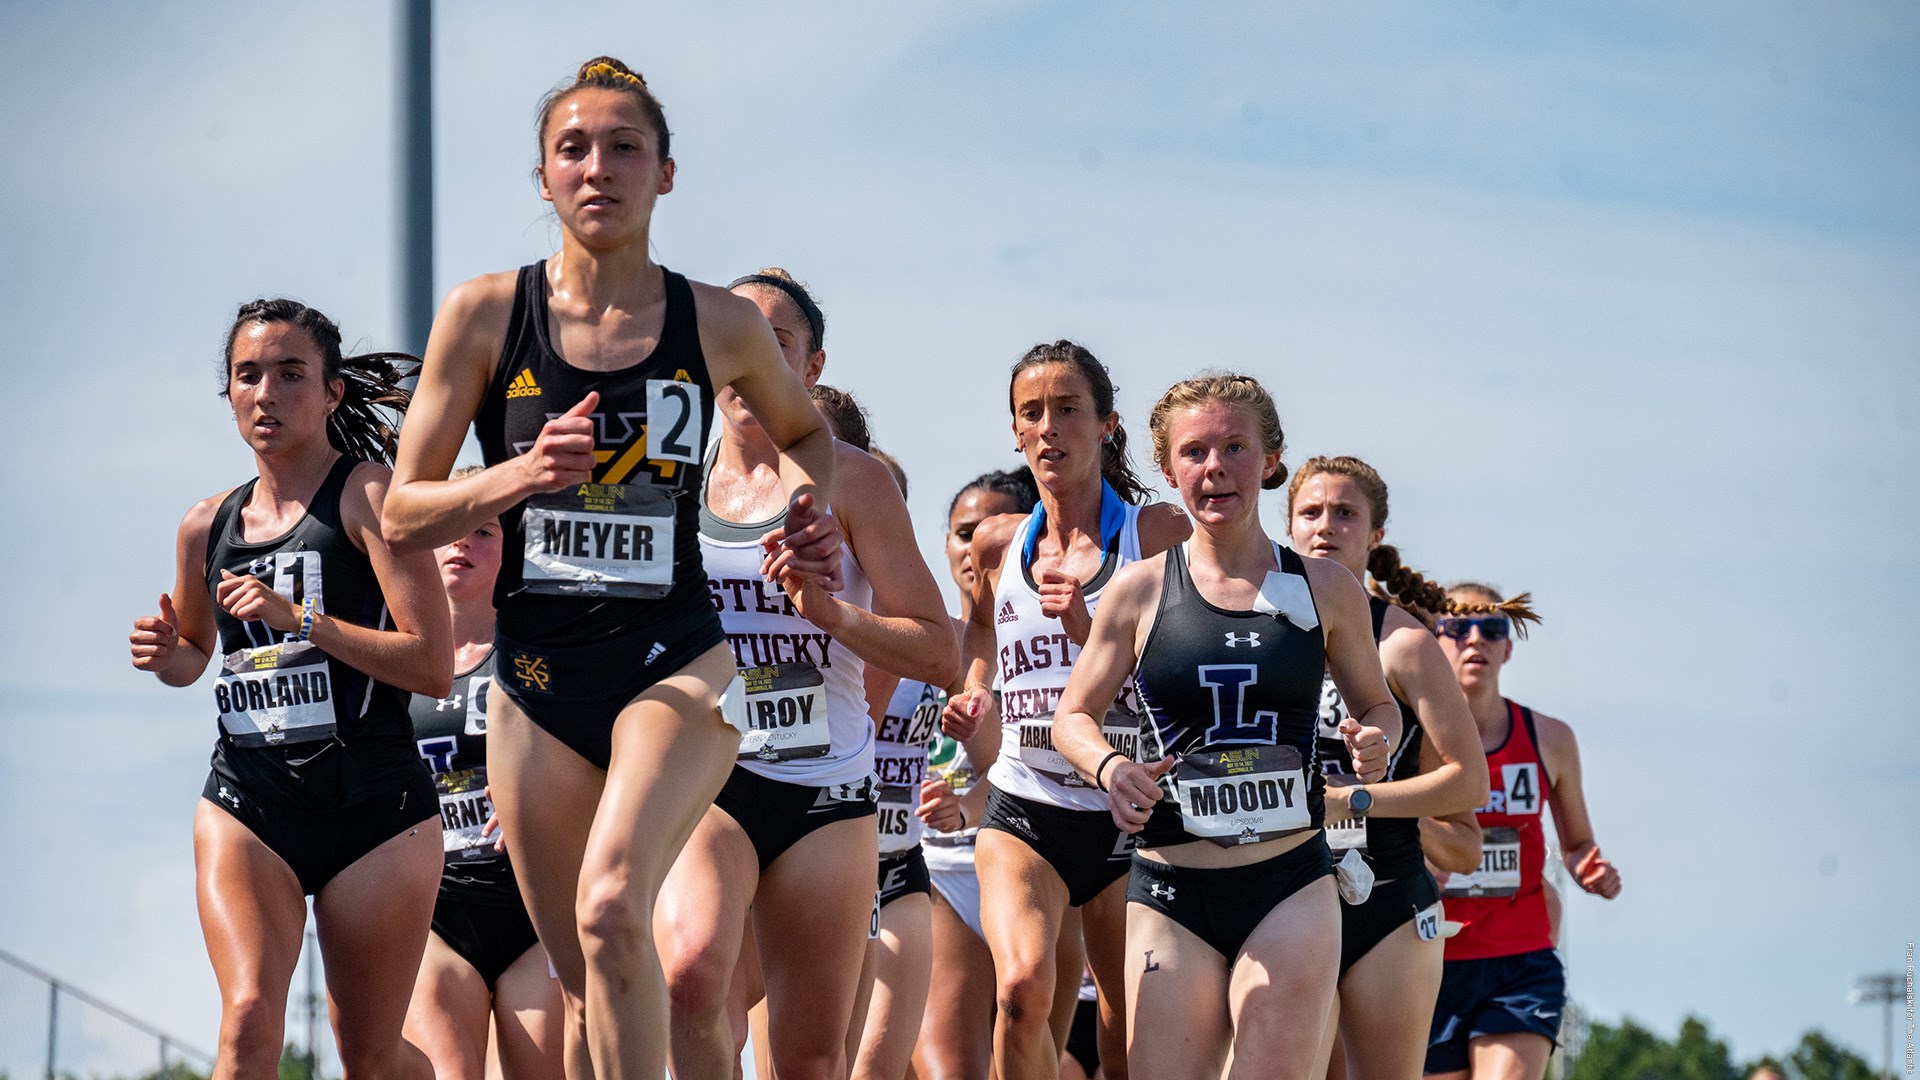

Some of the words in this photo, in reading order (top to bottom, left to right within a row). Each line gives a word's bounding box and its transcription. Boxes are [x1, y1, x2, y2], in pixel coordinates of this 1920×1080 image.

[506, 387, 541, 399] adidas
[661, 384, 692, 457] 2
[577, 483, 624, 499] ASUN
[543, 518, 653, 561] MEYER
[283, 556, 305, 606] 1
[707, 579, 803, 619] STE
[726, 633, 832, 668] TUCKY
[1001, 634, 1075, 685] EAST
[215, 670, 329, 714] BORLAND
[740, 665, 778, 681] ASUN
[746, 694, 815, 730] LROY
[907, 703, 939, 743] 29
[1198, 664, 1278, 745] L
[1323, 687, 1342, 728] 3
[1020, 724, 1057, 752] ZABAL
[1104, 732, 1138, 763] NAGA
[1220, 748, 1260, 764] ASUN
[1189, 776, 1295, 817] MOODY
[1511, 768, 1534, 810] 4
[440, 796, 490, 831] RNE
[1477, 850, 1517, 872] TLER
[1144, 950, 1160, 973] L
